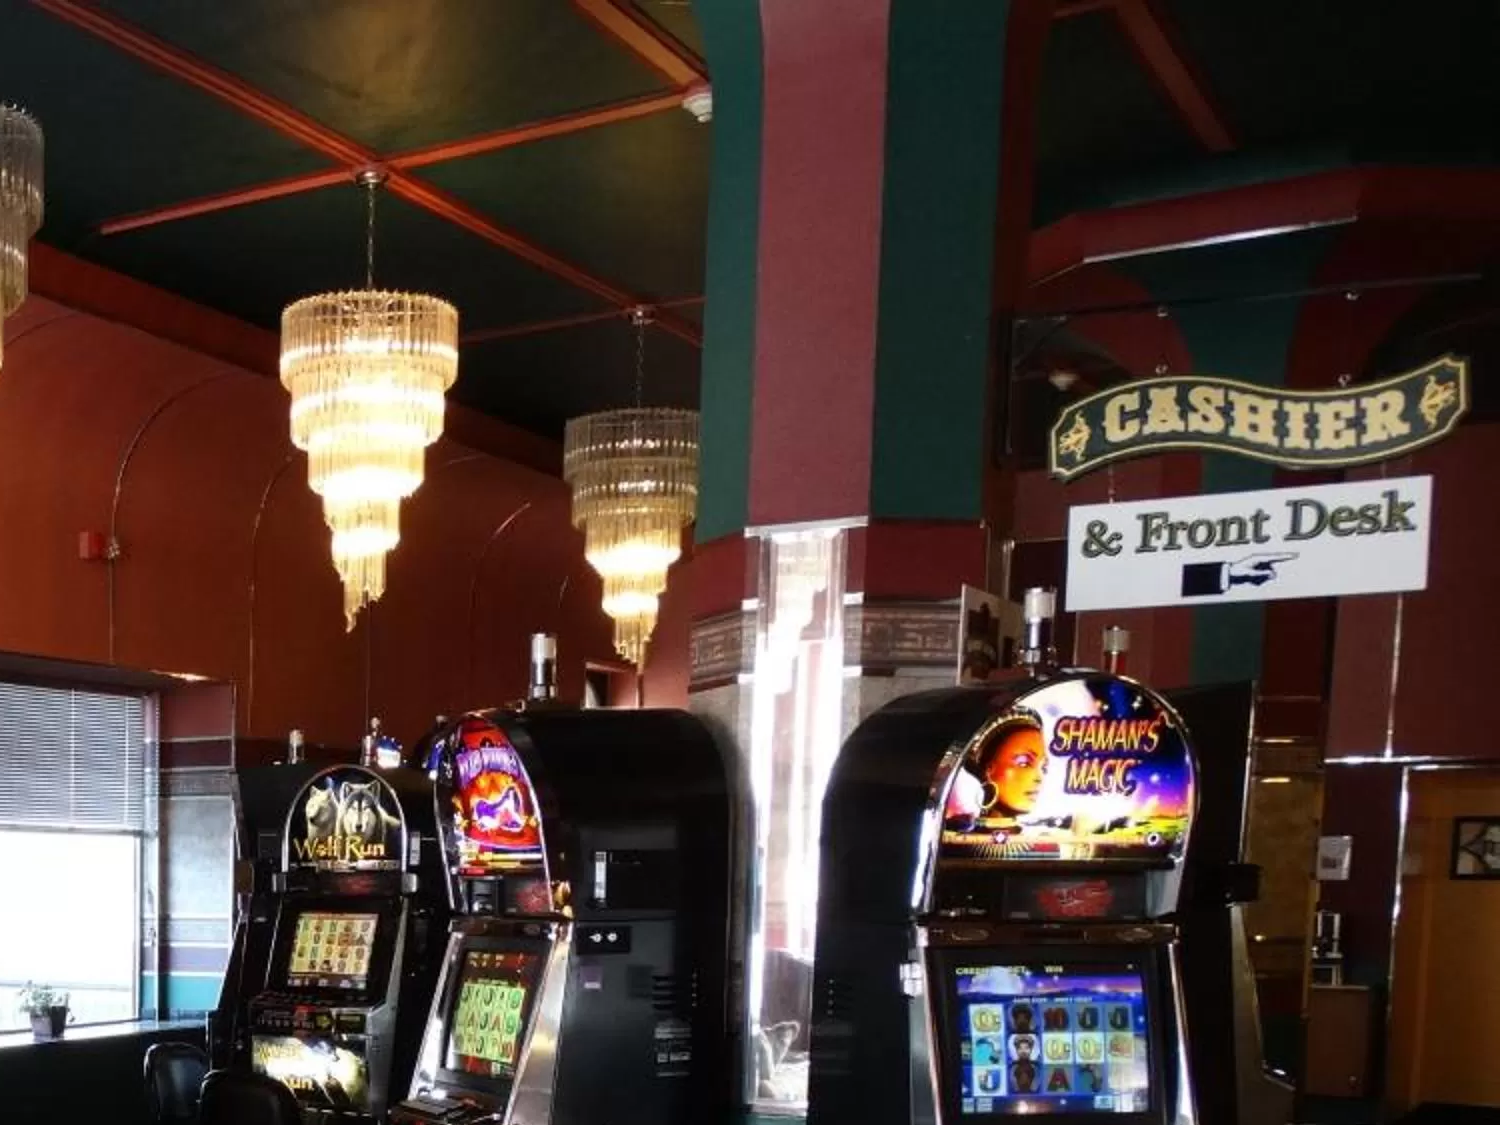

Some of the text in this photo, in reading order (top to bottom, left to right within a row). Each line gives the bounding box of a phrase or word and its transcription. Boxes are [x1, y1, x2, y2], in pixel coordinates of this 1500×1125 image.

[1102, 384, 1411, 450] CASHIER
[1082, 490, 1417, 558] & Front Desk
[1053, 716, 1161, 753] SHAMAN'S
[1068, 758, 1133, 793] MAGIC
[293, 834, 385, 861] Wolf Run
